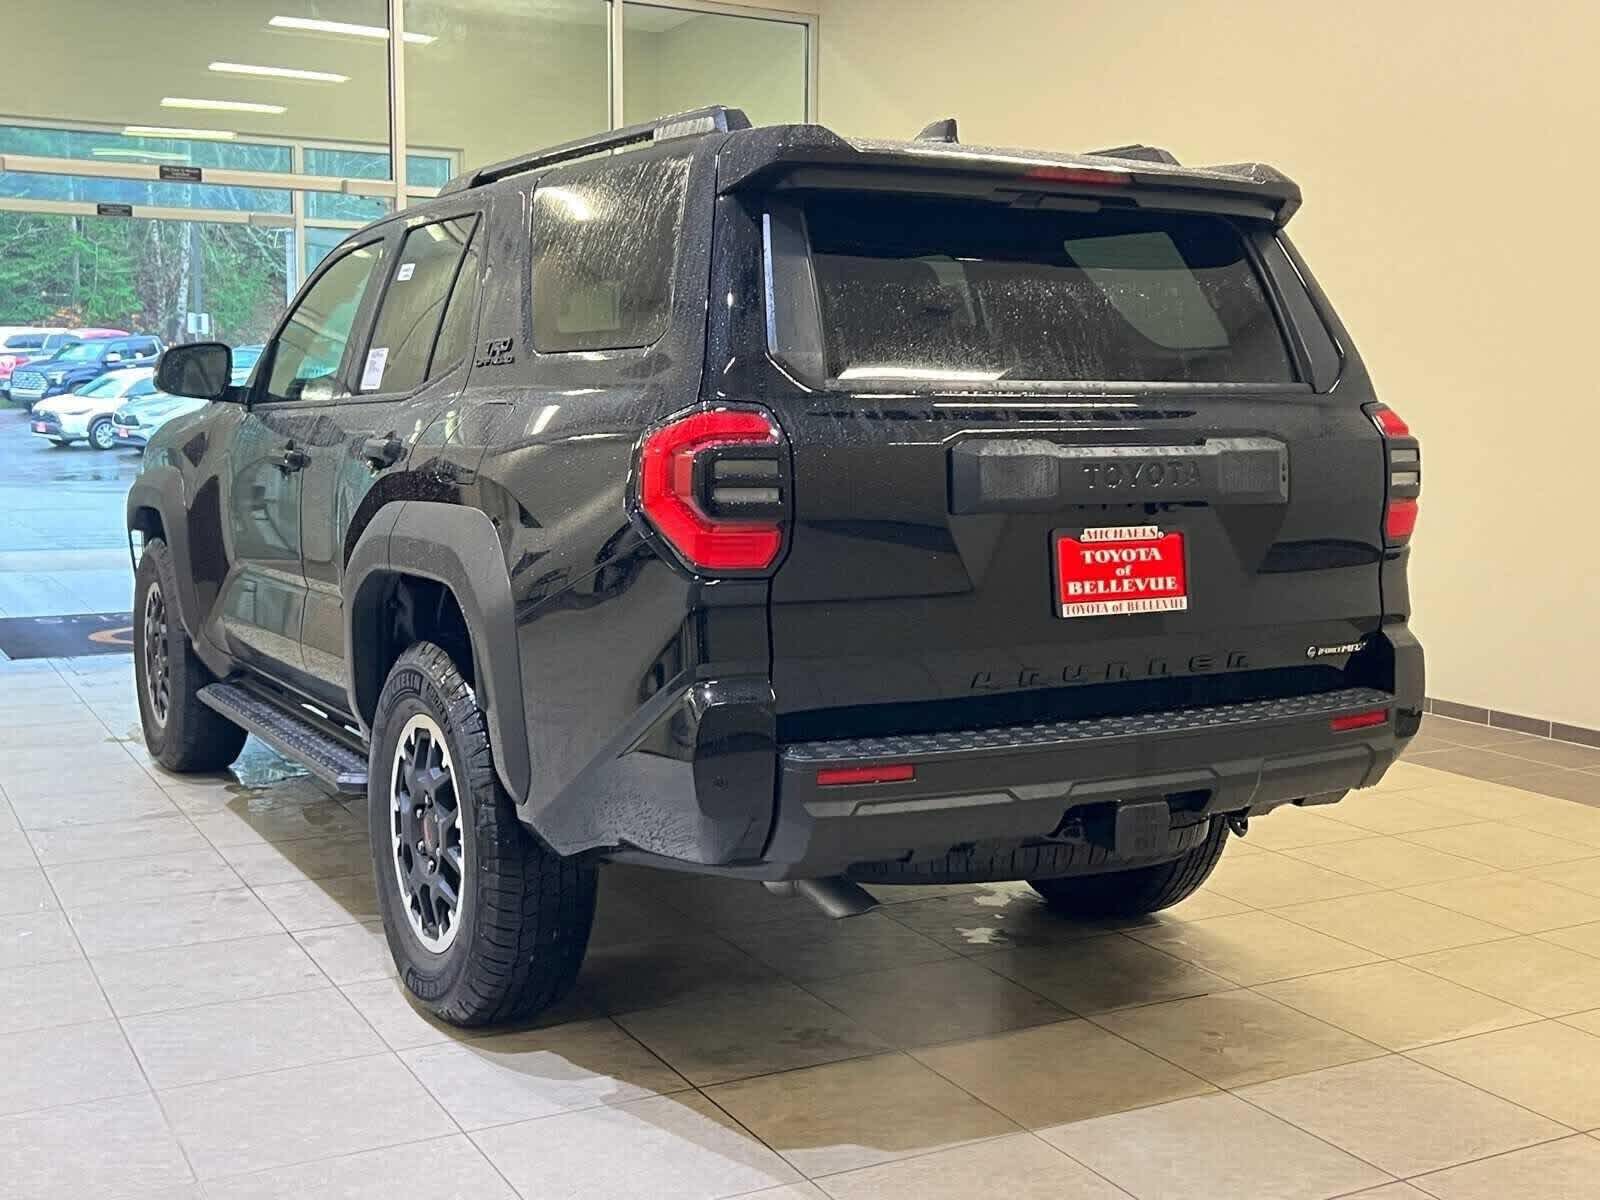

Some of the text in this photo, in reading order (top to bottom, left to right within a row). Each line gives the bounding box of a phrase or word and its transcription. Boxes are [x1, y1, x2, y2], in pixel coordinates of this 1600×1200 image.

[1081, 462, 1200, 489] TOYOTA
[1085, 527, 1157, 540] MICHAELS
[1080, 547, 1162, 564] TOYOTA
[1115, 564, 1132, 577] of
[1066, 576, 1178, 595] BELLEVUE
[1064, 603, 1109, 616] TOYOTA
[1127, 598, 1184, 613] BELLEVUE
